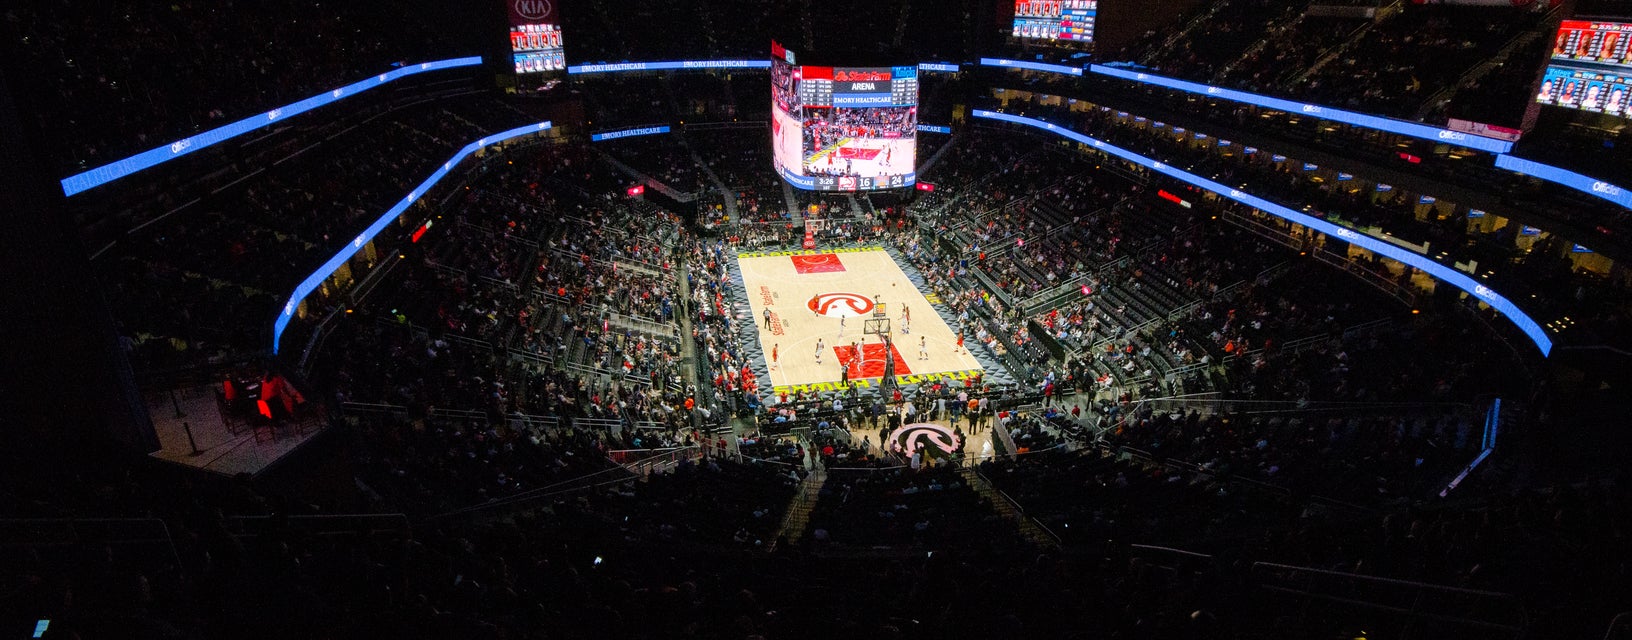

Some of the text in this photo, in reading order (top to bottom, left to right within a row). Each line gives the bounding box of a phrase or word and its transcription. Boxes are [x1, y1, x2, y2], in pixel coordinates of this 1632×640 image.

[521, 0, 546, 14] KIA
[582, 63, 646, 72] EMORY HEALTHCARE
[851, 83, 875, 91] ARENA
[834, 96, 892, 104] EMORY HEALTHCARE
[1439, 130, 1465, 140] Official
[860, 178, 870, 187] 16
[892, 175, 902, 185] 24
[1593, 182, 1619, 196] Official
